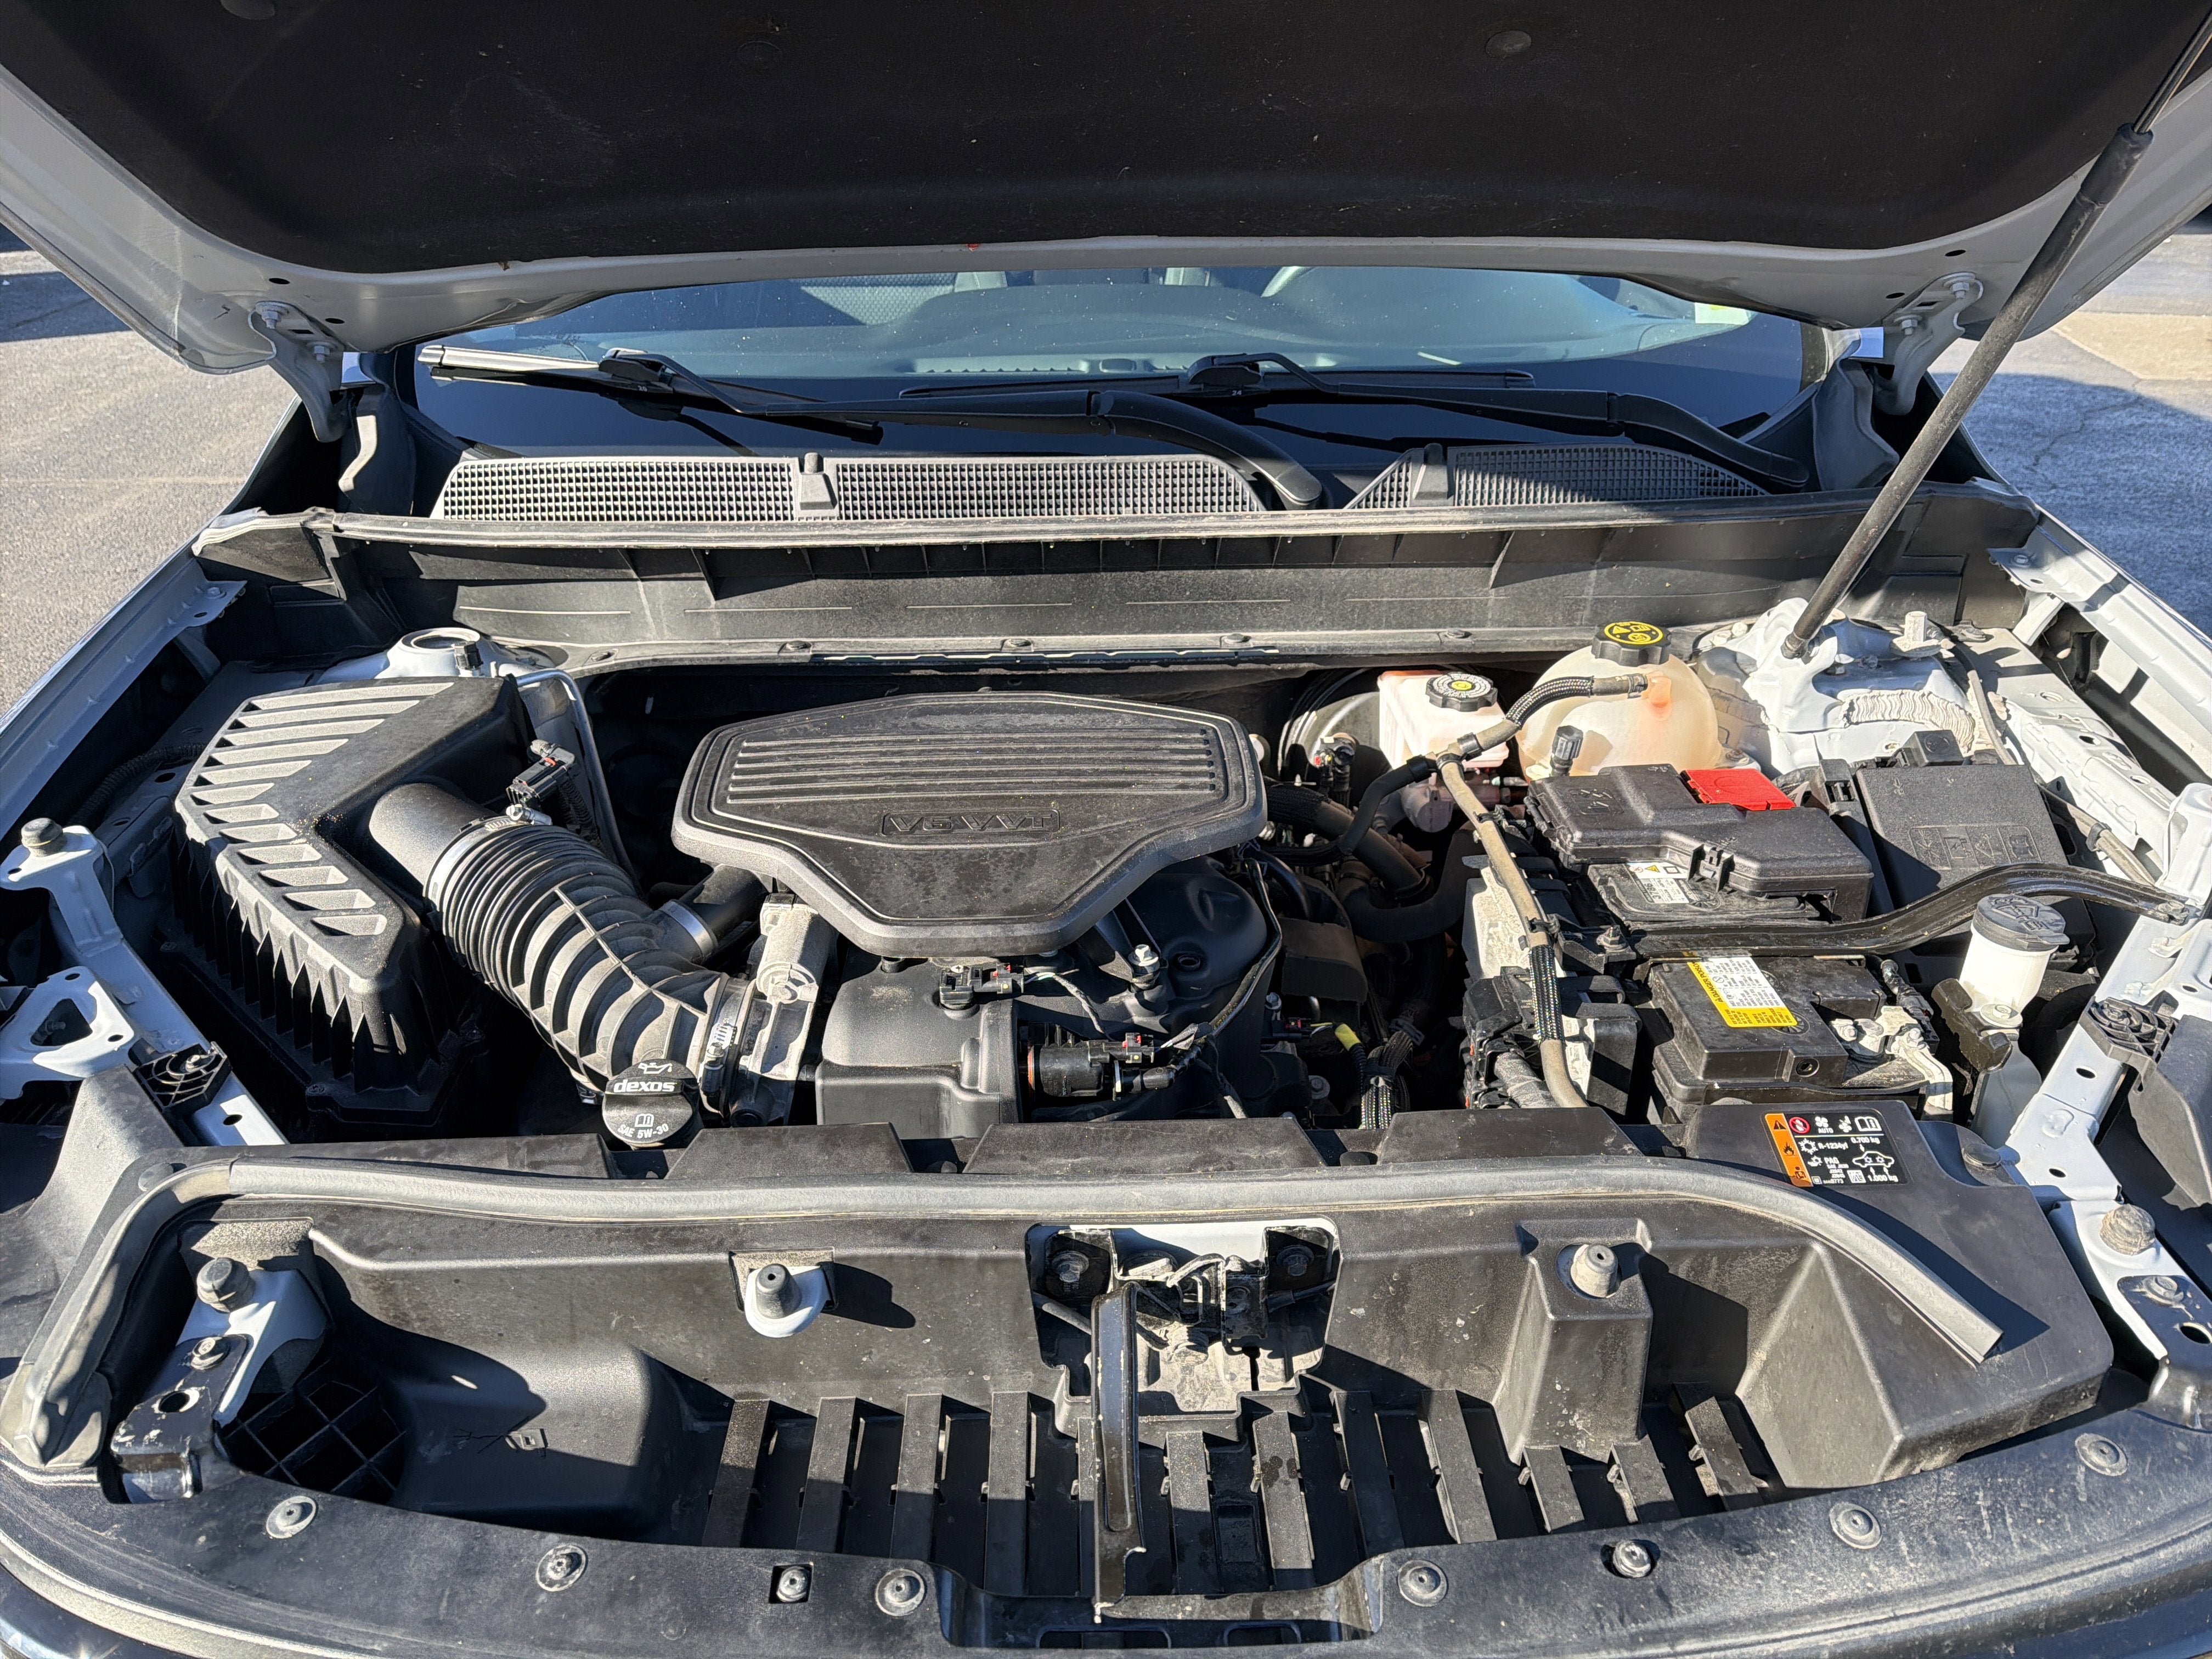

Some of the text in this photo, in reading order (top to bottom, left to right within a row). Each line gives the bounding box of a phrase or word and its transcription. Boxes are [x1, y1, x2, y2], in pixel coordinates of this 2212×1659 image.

[613, 1079, 676, 1093] dexos
[617, 1123, 669, 1139] SAE 5W-30
[1870, 1136, 1881, 1144] kg
